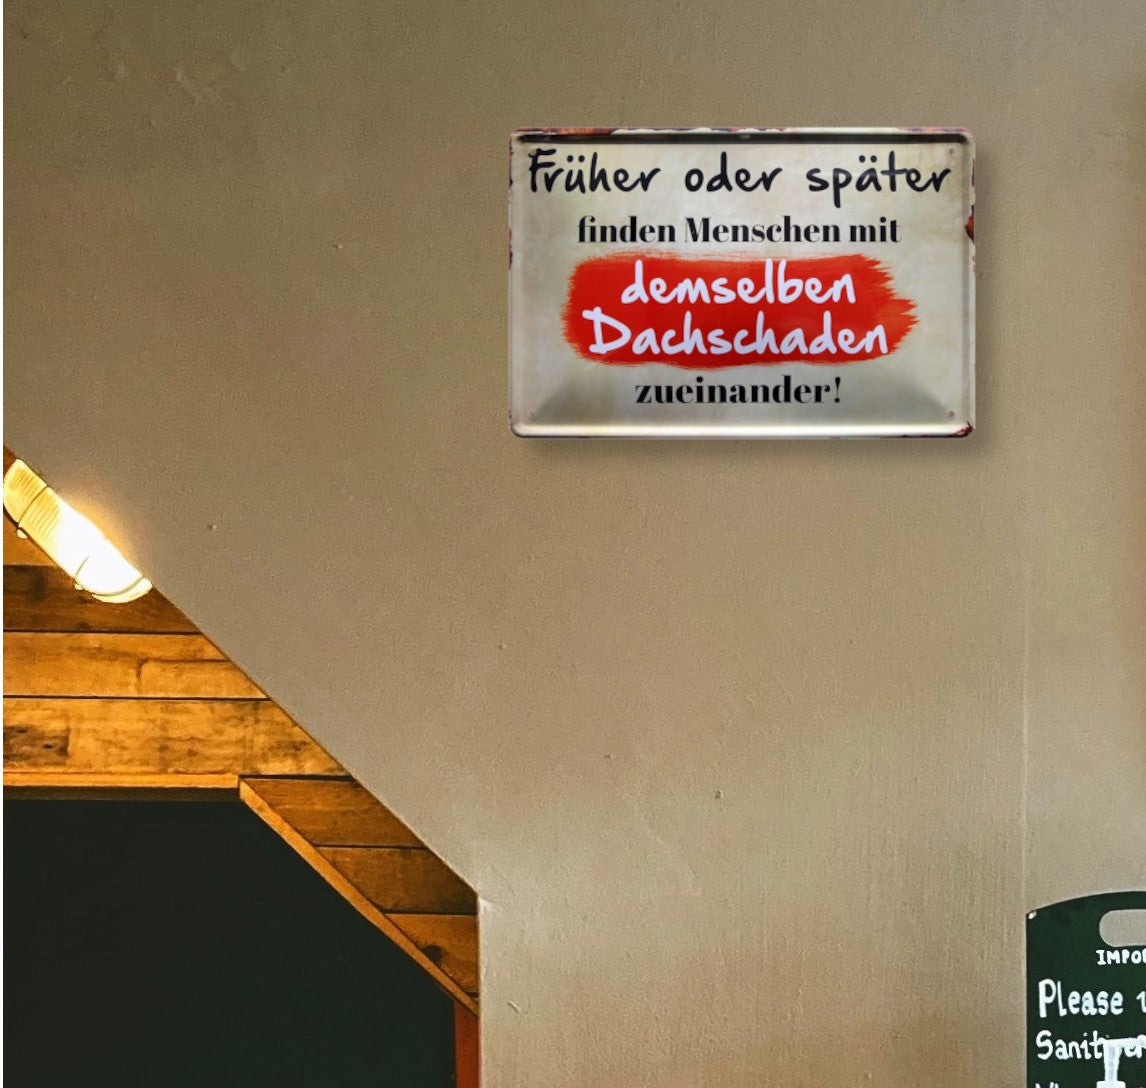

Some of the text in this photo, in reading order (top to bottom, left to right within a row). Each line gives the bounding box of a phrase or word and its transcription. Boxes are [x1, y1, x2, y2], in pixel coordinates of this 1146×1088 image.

[528, 148, 951, 208] Früher oder später
[577, 215, 902, 244] finden Menschen mit
[621, 258, 856, 306] demselben
[582, 306, 889, 355] Dachschaden
[635, 375, 842, 405] zueinander!
[1038, 978, 1124, 1018] Please
[1036, 1029, 1143, 1060] Saniter
